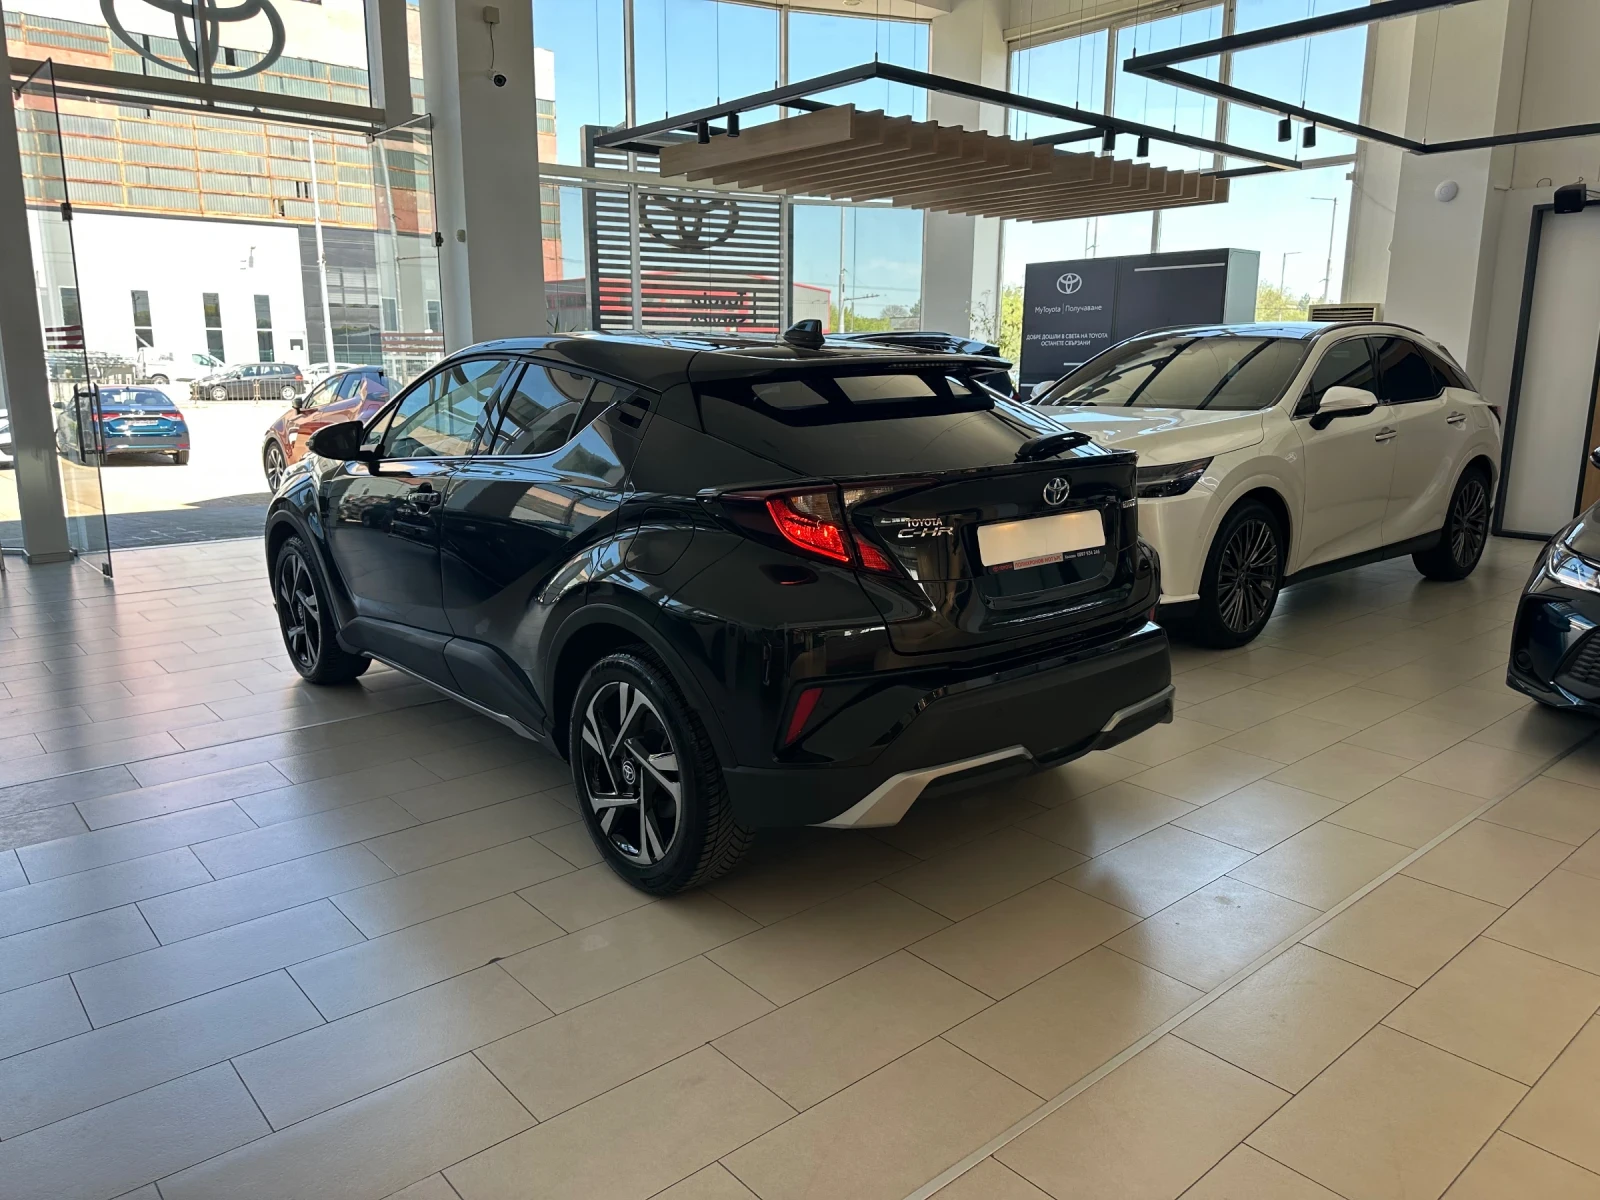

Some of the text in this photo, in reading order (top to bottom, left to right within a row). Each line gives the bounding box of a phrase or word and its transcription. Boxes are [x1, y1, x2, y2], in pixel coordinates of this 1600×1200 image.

[1035, 306, 1061, 314] MyToyota
[1065, 304, 1102, 313] Получаване
[907, 518, 943, 528] TOYOTA
[897, 527, 954, 539] C-HR
